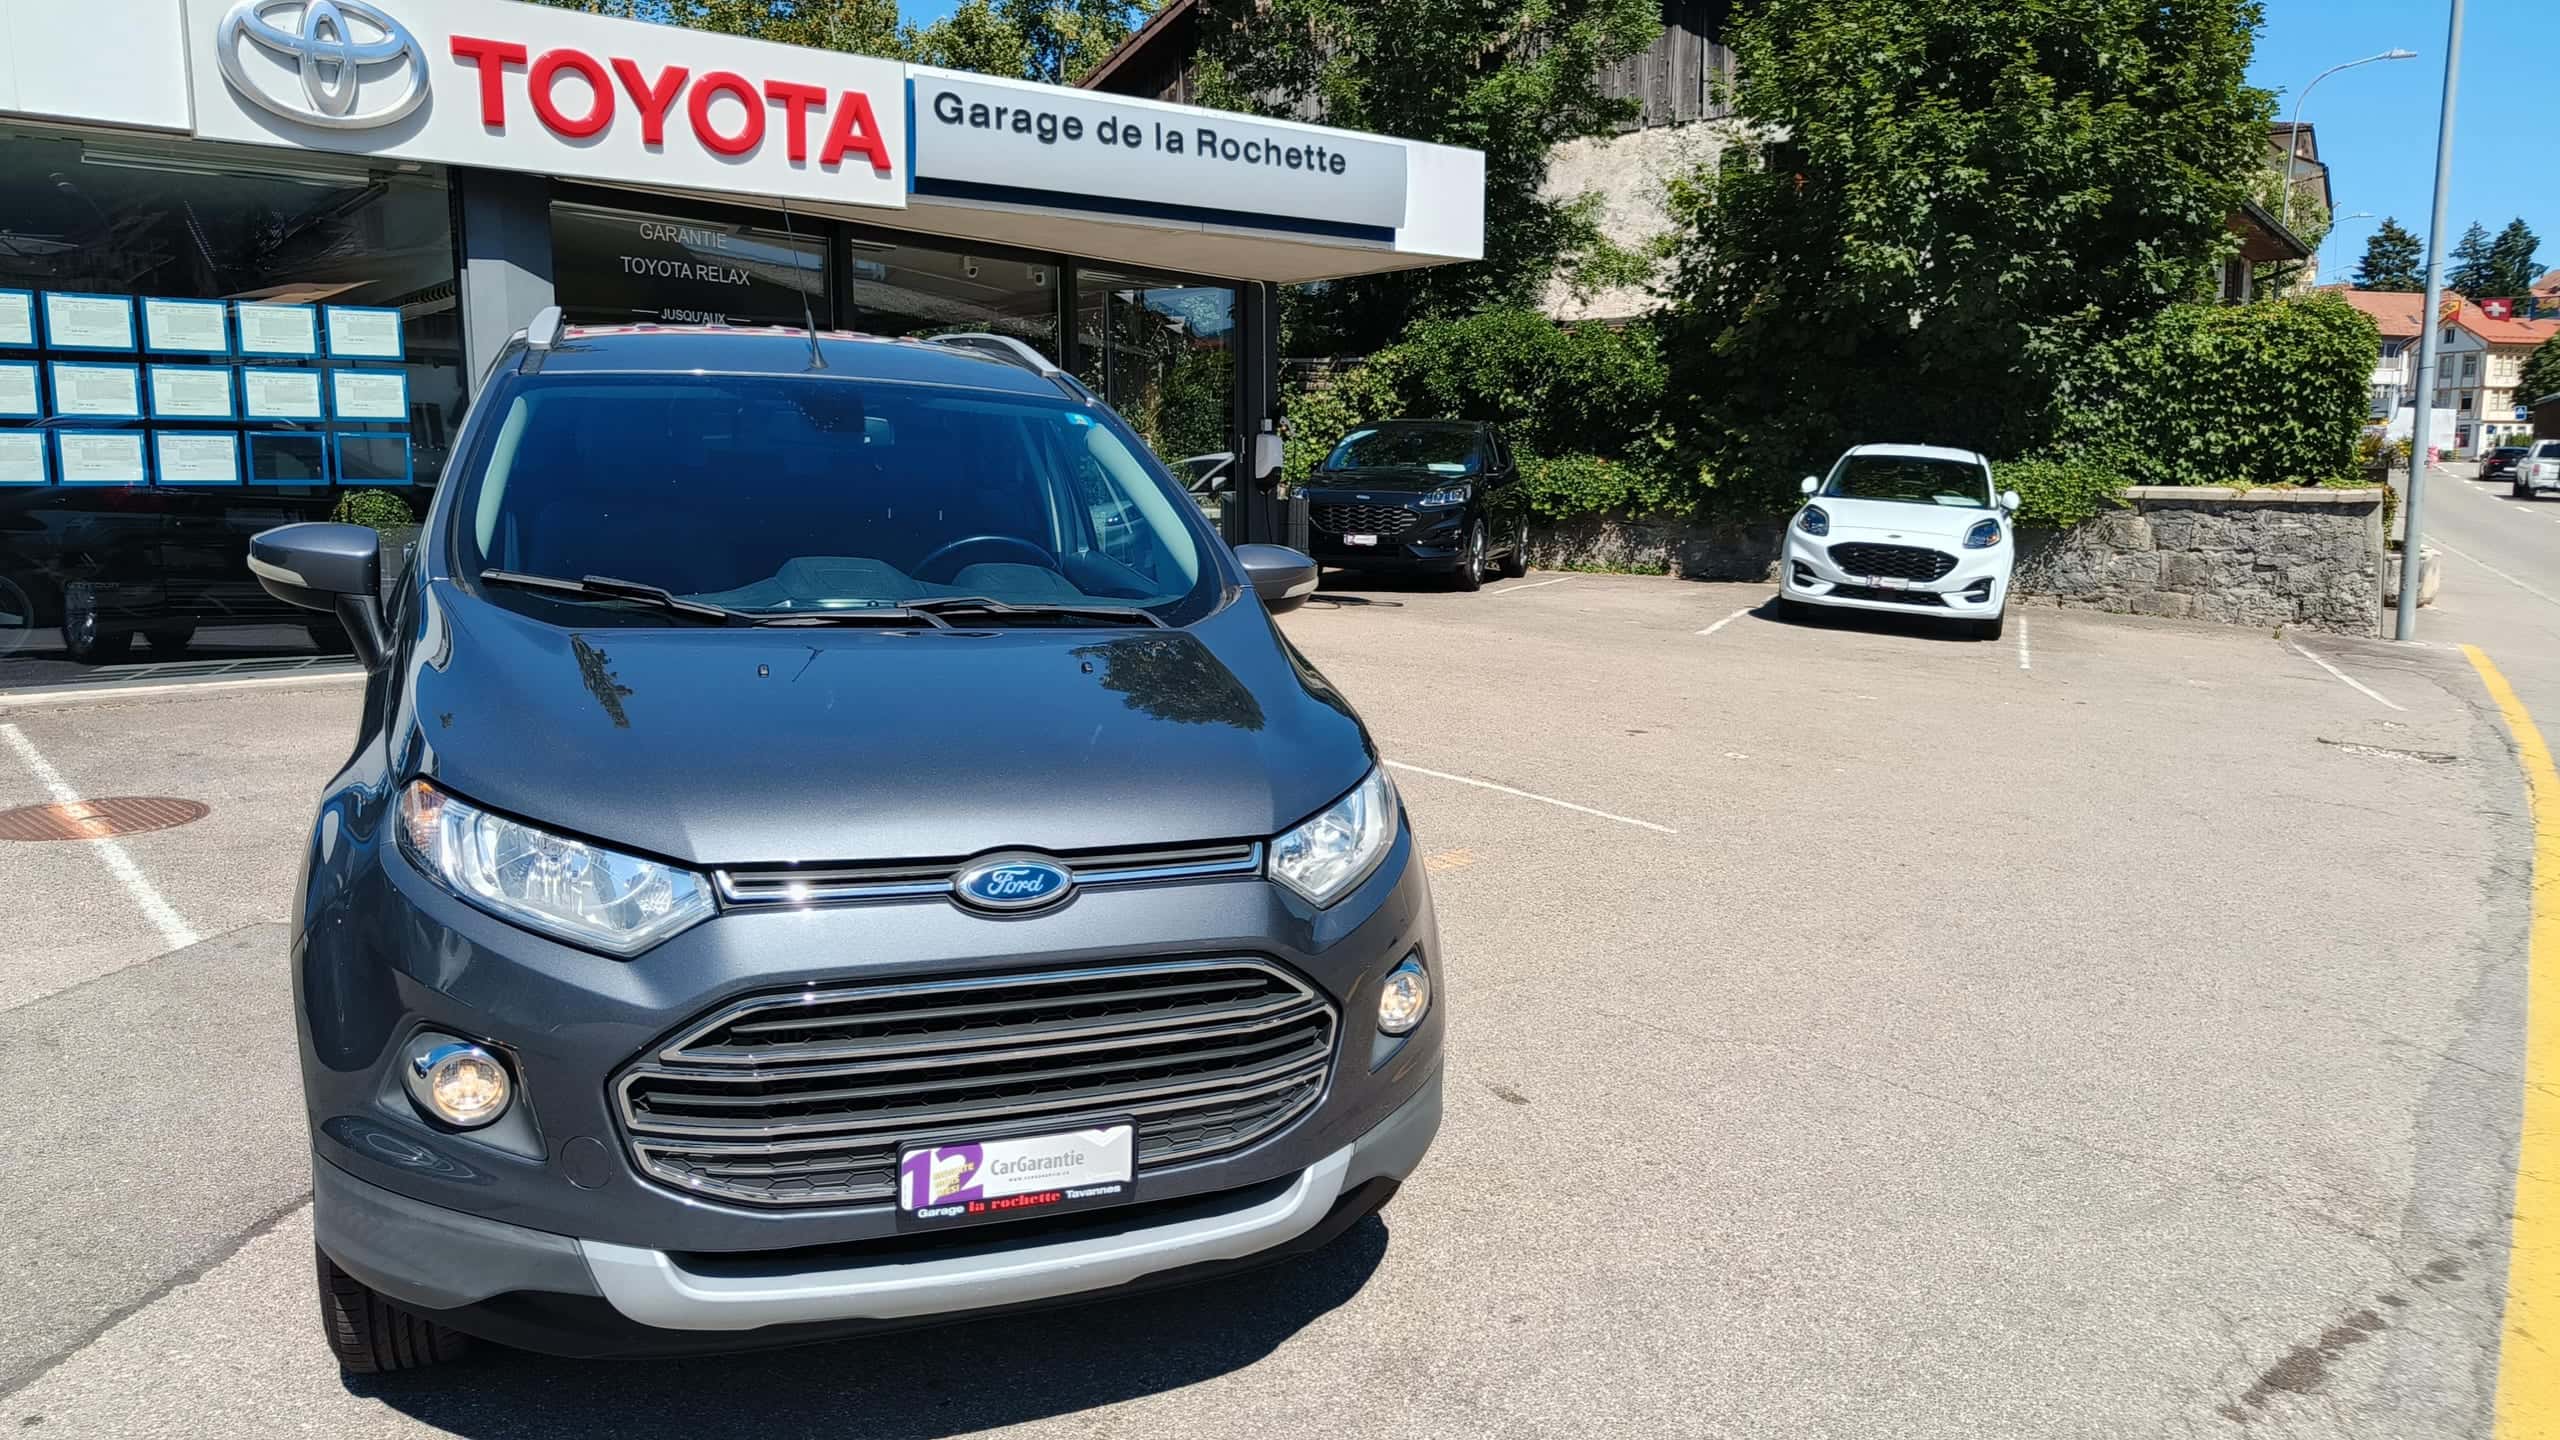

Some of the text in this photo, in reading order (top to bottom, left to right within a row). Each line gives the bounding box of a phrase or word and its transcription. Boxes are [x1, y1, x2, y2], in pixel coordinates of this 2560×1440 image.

[450, 35, 891, 171] TOYOTA
[933, 91, 1347, 176] Garage de la Rochette
[639, 222, 729, 249] GARANTIE
[620, 256, 751, 286] TOYOTA RELAX
[661, 308, 726, 324] JUSQU'AUX
[987, 869, 1044, 895] Ford
[991, 1150, 1085, 1176] CarGarantie
[969, 1201, 985, 1213] la
[991, 1191, 1062, 1210] rochette
[1066, 1184, 1122, 1199] Tavannes
